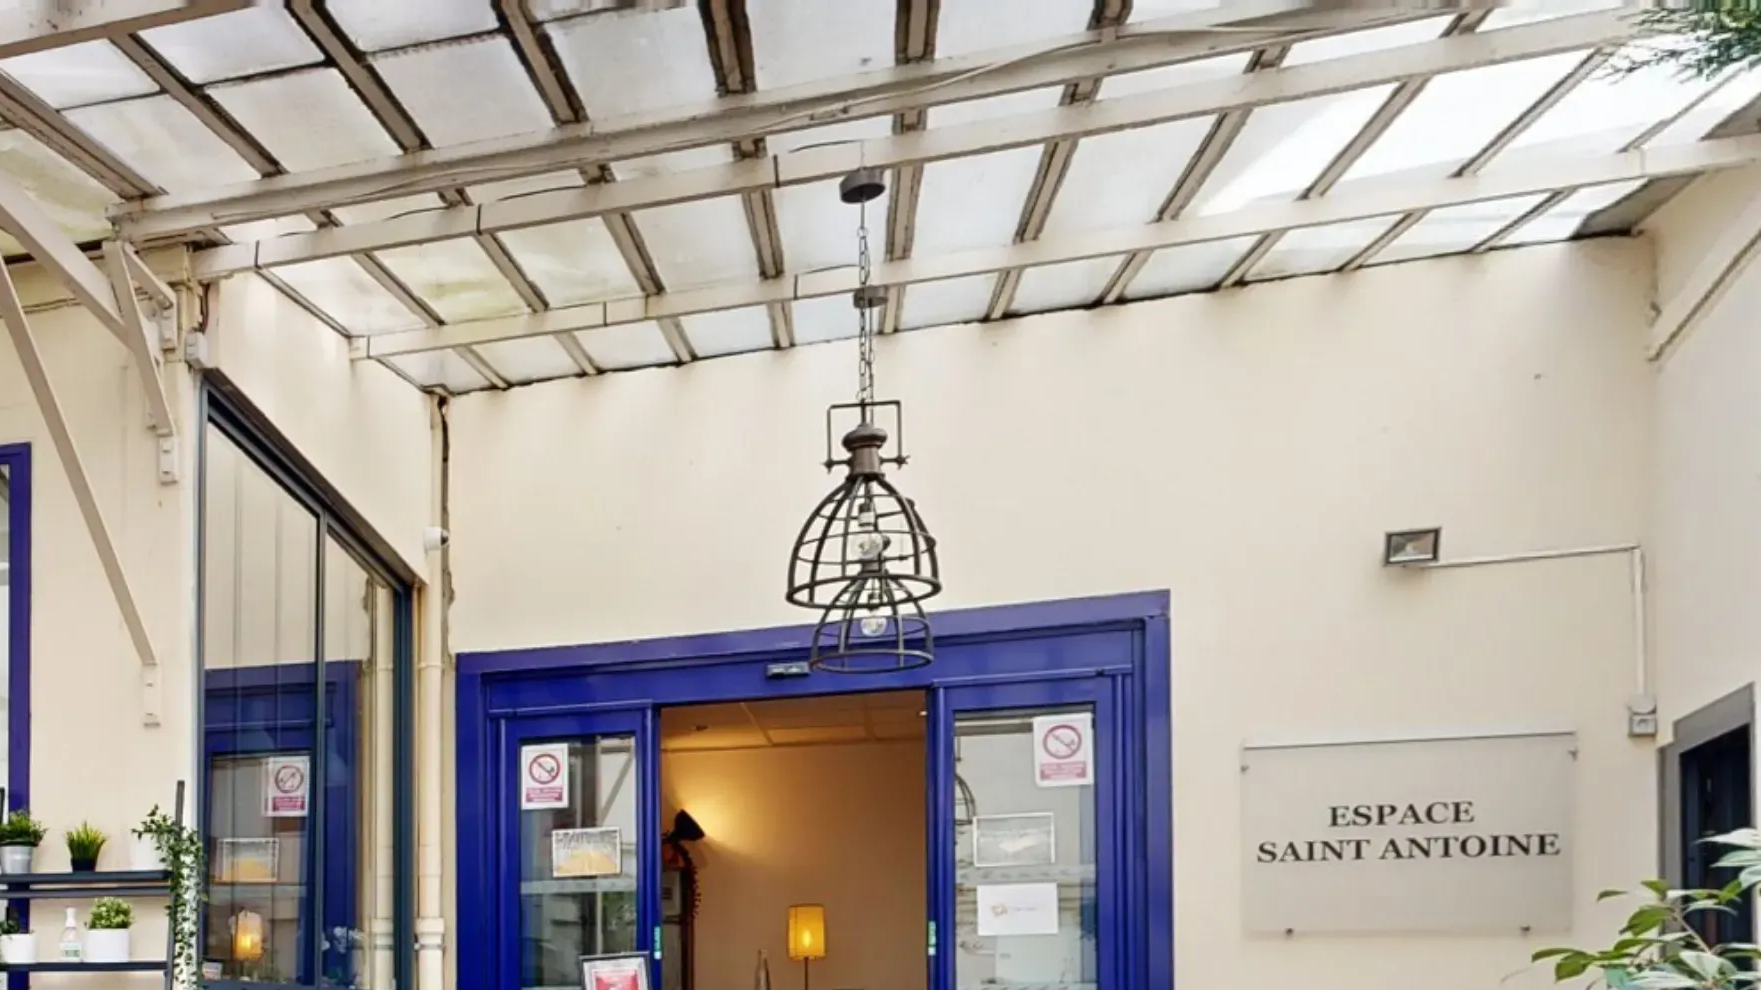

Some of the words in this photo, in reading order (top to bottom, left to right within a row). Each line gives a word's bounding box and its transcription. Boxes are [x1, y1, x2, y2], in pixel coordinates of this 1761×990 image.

[1328, 801, 1476, 828] ESPACE
[1256, 839, 1371, 863] SAINT
[1378, 833, 1562, 860] ANTOINE
